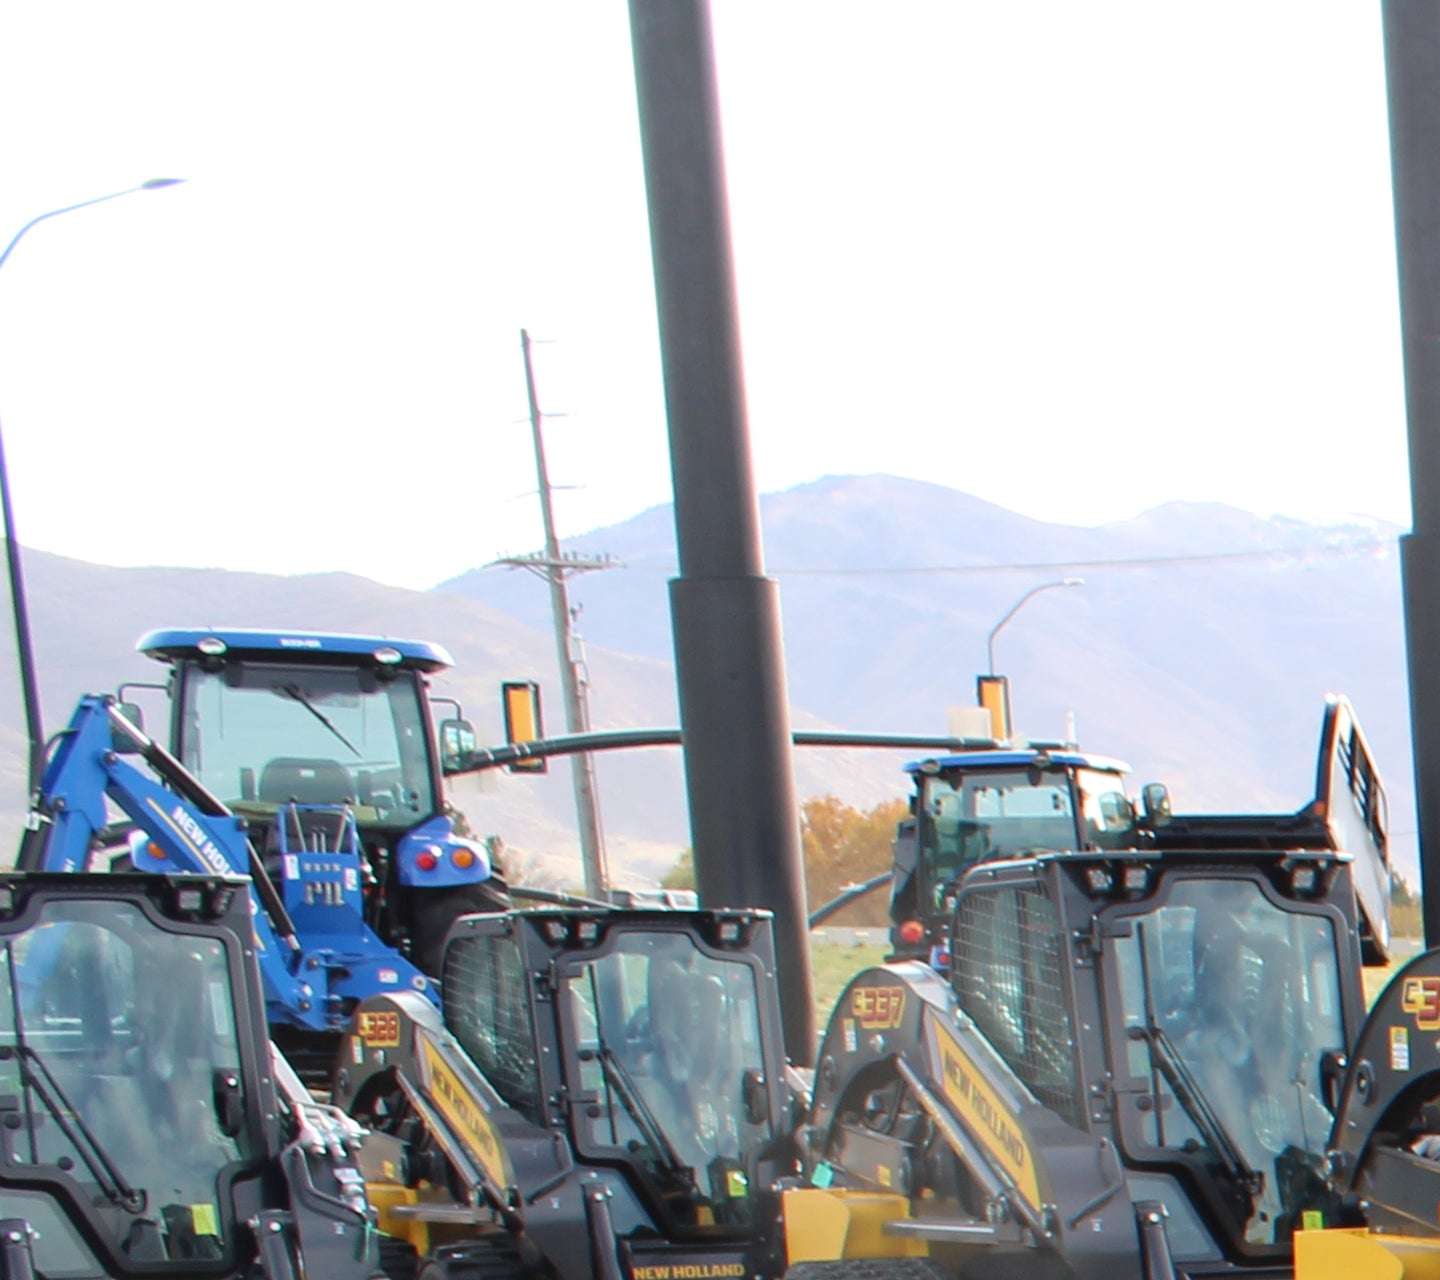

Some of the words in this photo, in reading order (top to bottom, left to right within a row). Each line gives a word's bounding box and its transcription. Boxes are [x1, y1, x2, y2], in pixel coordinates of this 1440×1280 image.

[172, 805, 208, 847] NEW
[970, 1082, 1024, 1167] HOLLAND
[632, 1265, 670, 1280] NEW
[672, 1263, 746, 1279] HOLLAND
